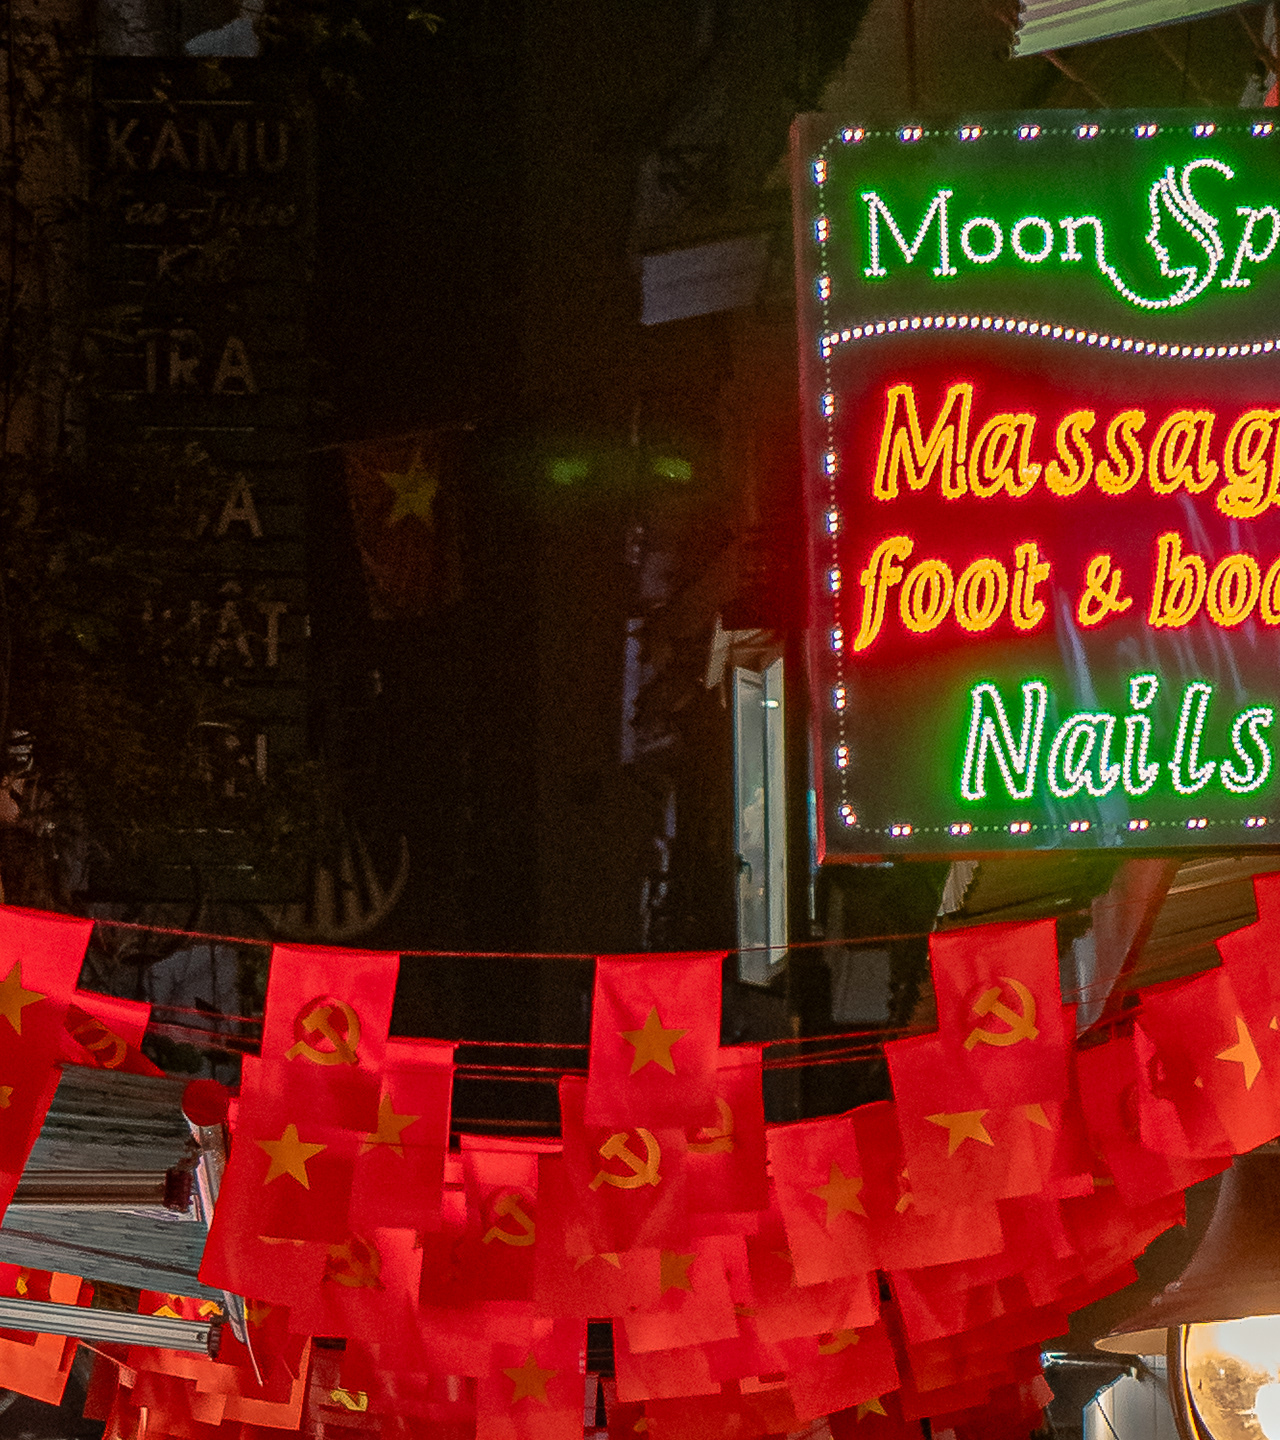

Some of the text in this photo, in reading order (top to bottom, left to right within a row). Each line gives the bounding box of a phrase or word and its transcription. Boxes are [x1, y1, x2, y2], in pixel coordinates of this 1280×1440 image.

[106, 117, 289, 172] KAMU
[861, 189, 1110, 278] Moon
[853, 536, 1050, 651] foot
[1079, 556, 1133, 626] &
[960, 674, 1273, 800] Nails
